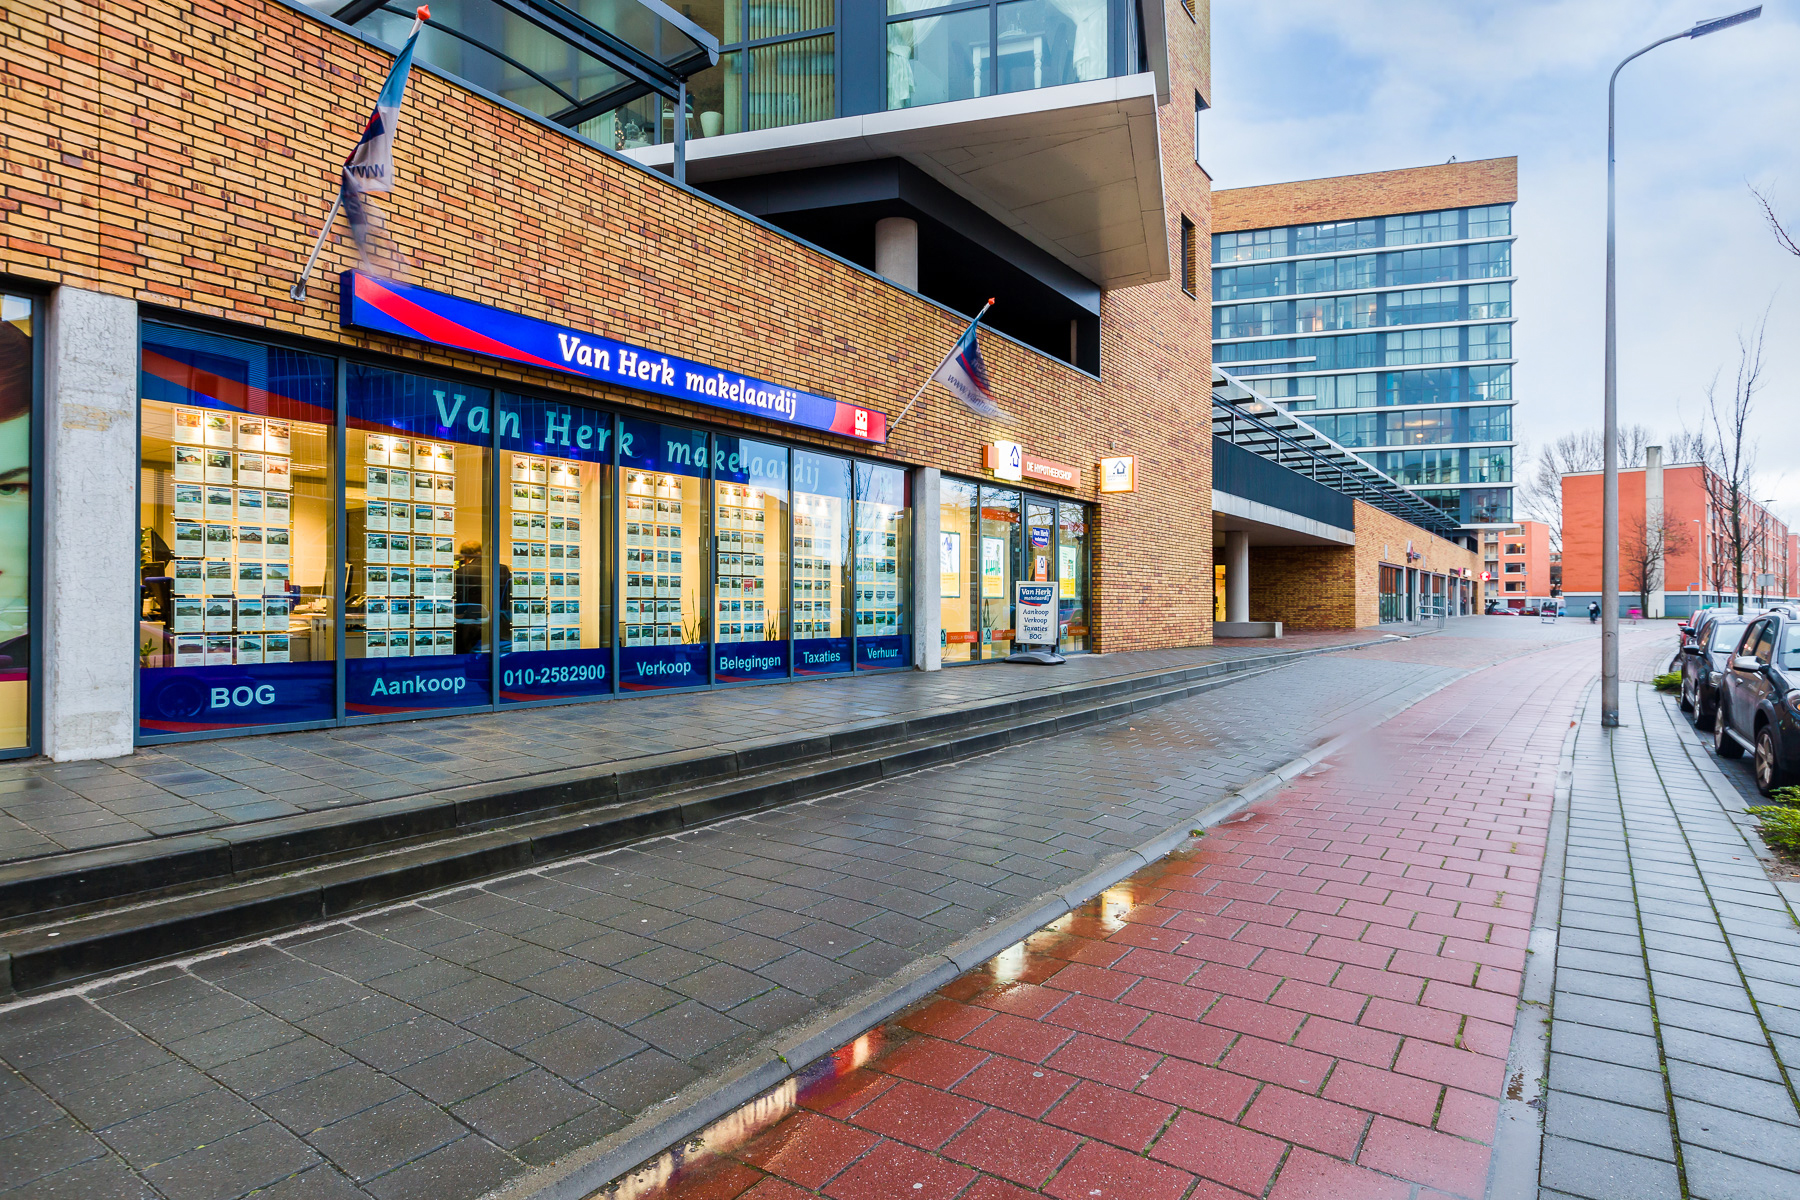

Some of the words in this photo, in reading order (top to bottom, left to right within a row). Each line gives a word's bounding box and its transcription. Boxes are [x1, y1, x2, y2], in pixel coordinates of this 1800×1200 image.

[558, 333, 610, 369] Van
[618, 349, 675, 386] Herk
[685, 370, 797, 421] makelaardij
[433, 390, 520, 438] Van
[545, 410, 634, 456] Herk
[667, 440, 820, 493] makelaardij
[1035, 588, 1052, 596] Herk
[1022, 608, 1049, 616] Aankoop
[1024, 616, 1048, 624] Verkoop
[803, 651, 841, 664] Taxaties
[867, 647, 899, 660] Verhuur
[636, 661, 692, 678] Verkoop
[719, 655, 781, 673] Belegingen
[503, 664, 606, 686] 010-2582900
[371, 674, 466, 697] Aankoop
[210, 684, 276, 708] BOG
